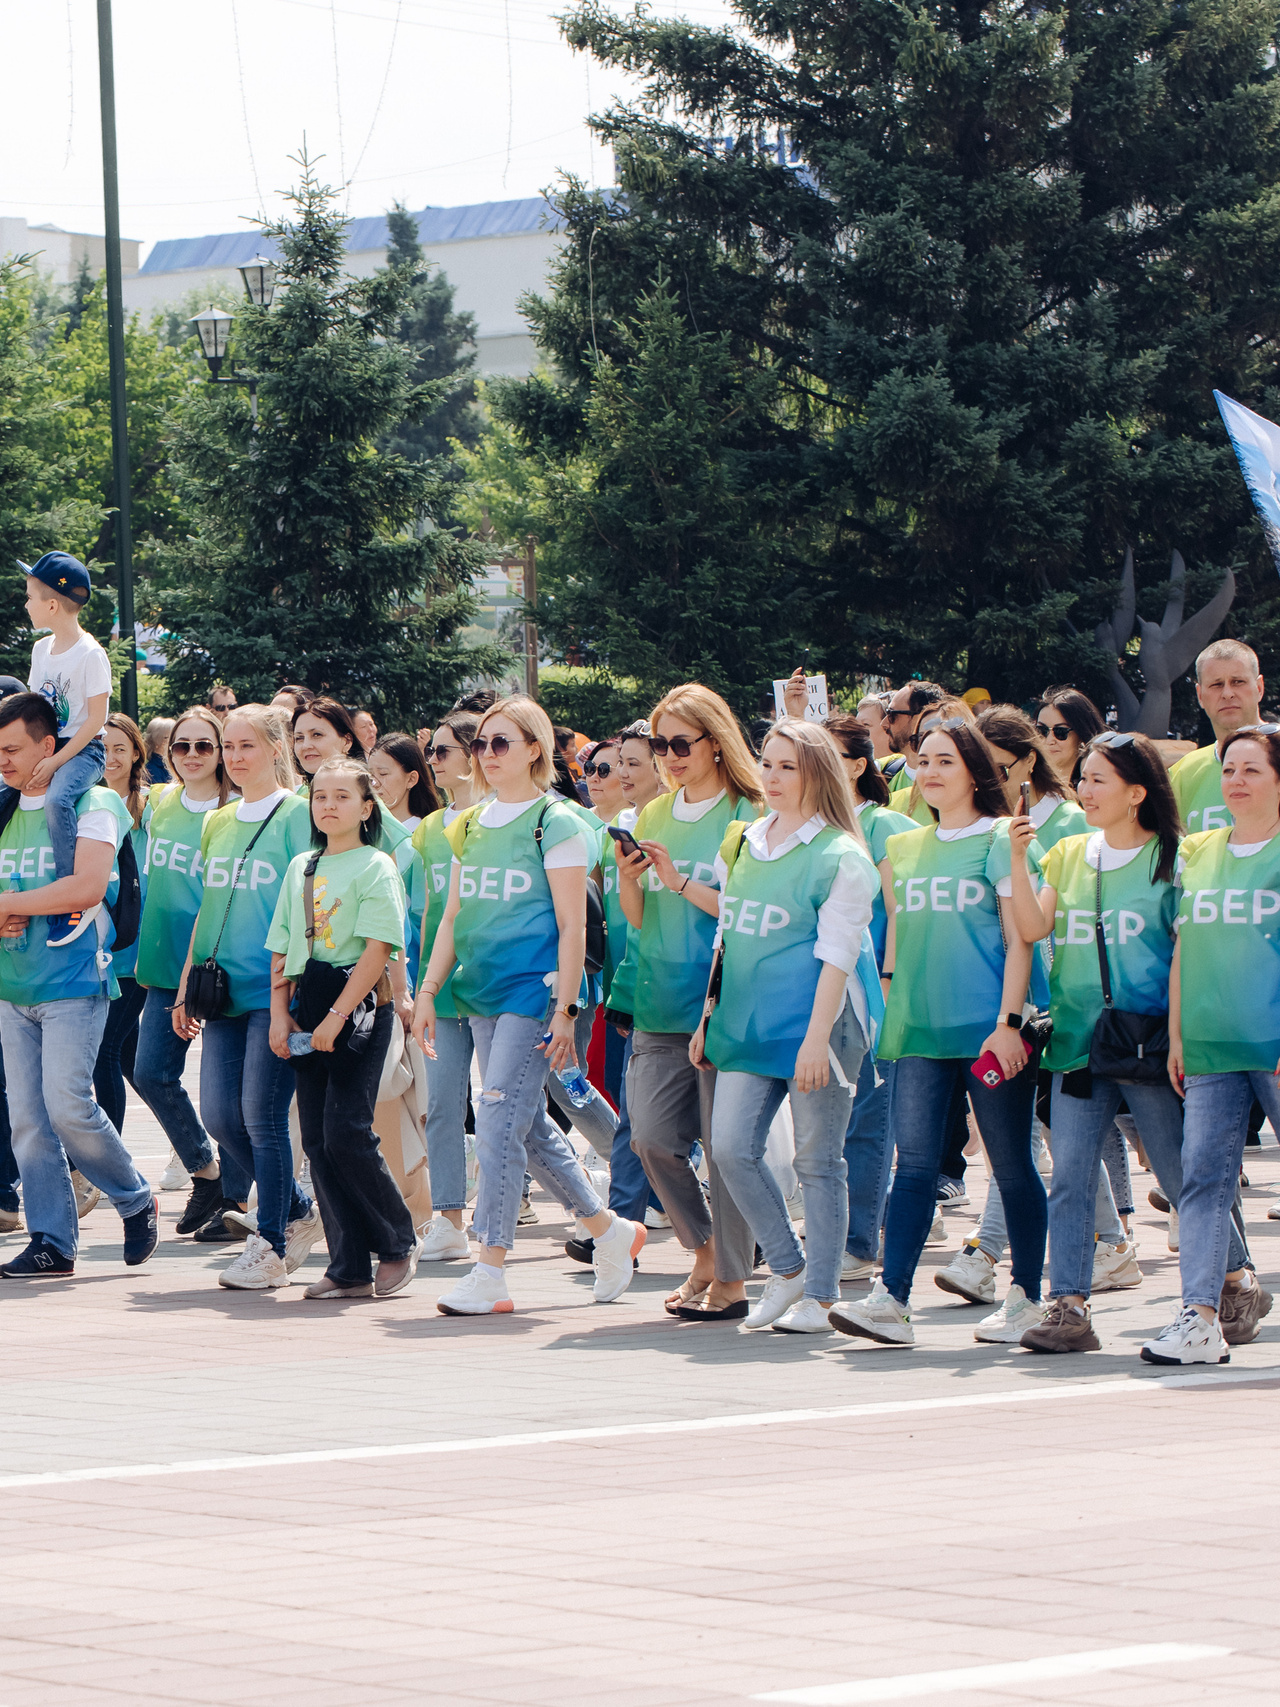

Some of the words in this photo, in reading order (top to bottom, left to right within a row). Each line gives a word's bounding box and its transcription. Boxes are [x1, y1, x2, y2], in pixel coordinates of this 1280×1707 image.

[203, 856, 277, 891] БЕР
[459, 865, 532, 902] БЕР
[723, 895, 791, 938] БЕР
[33, 1251, 54, 1269] N
